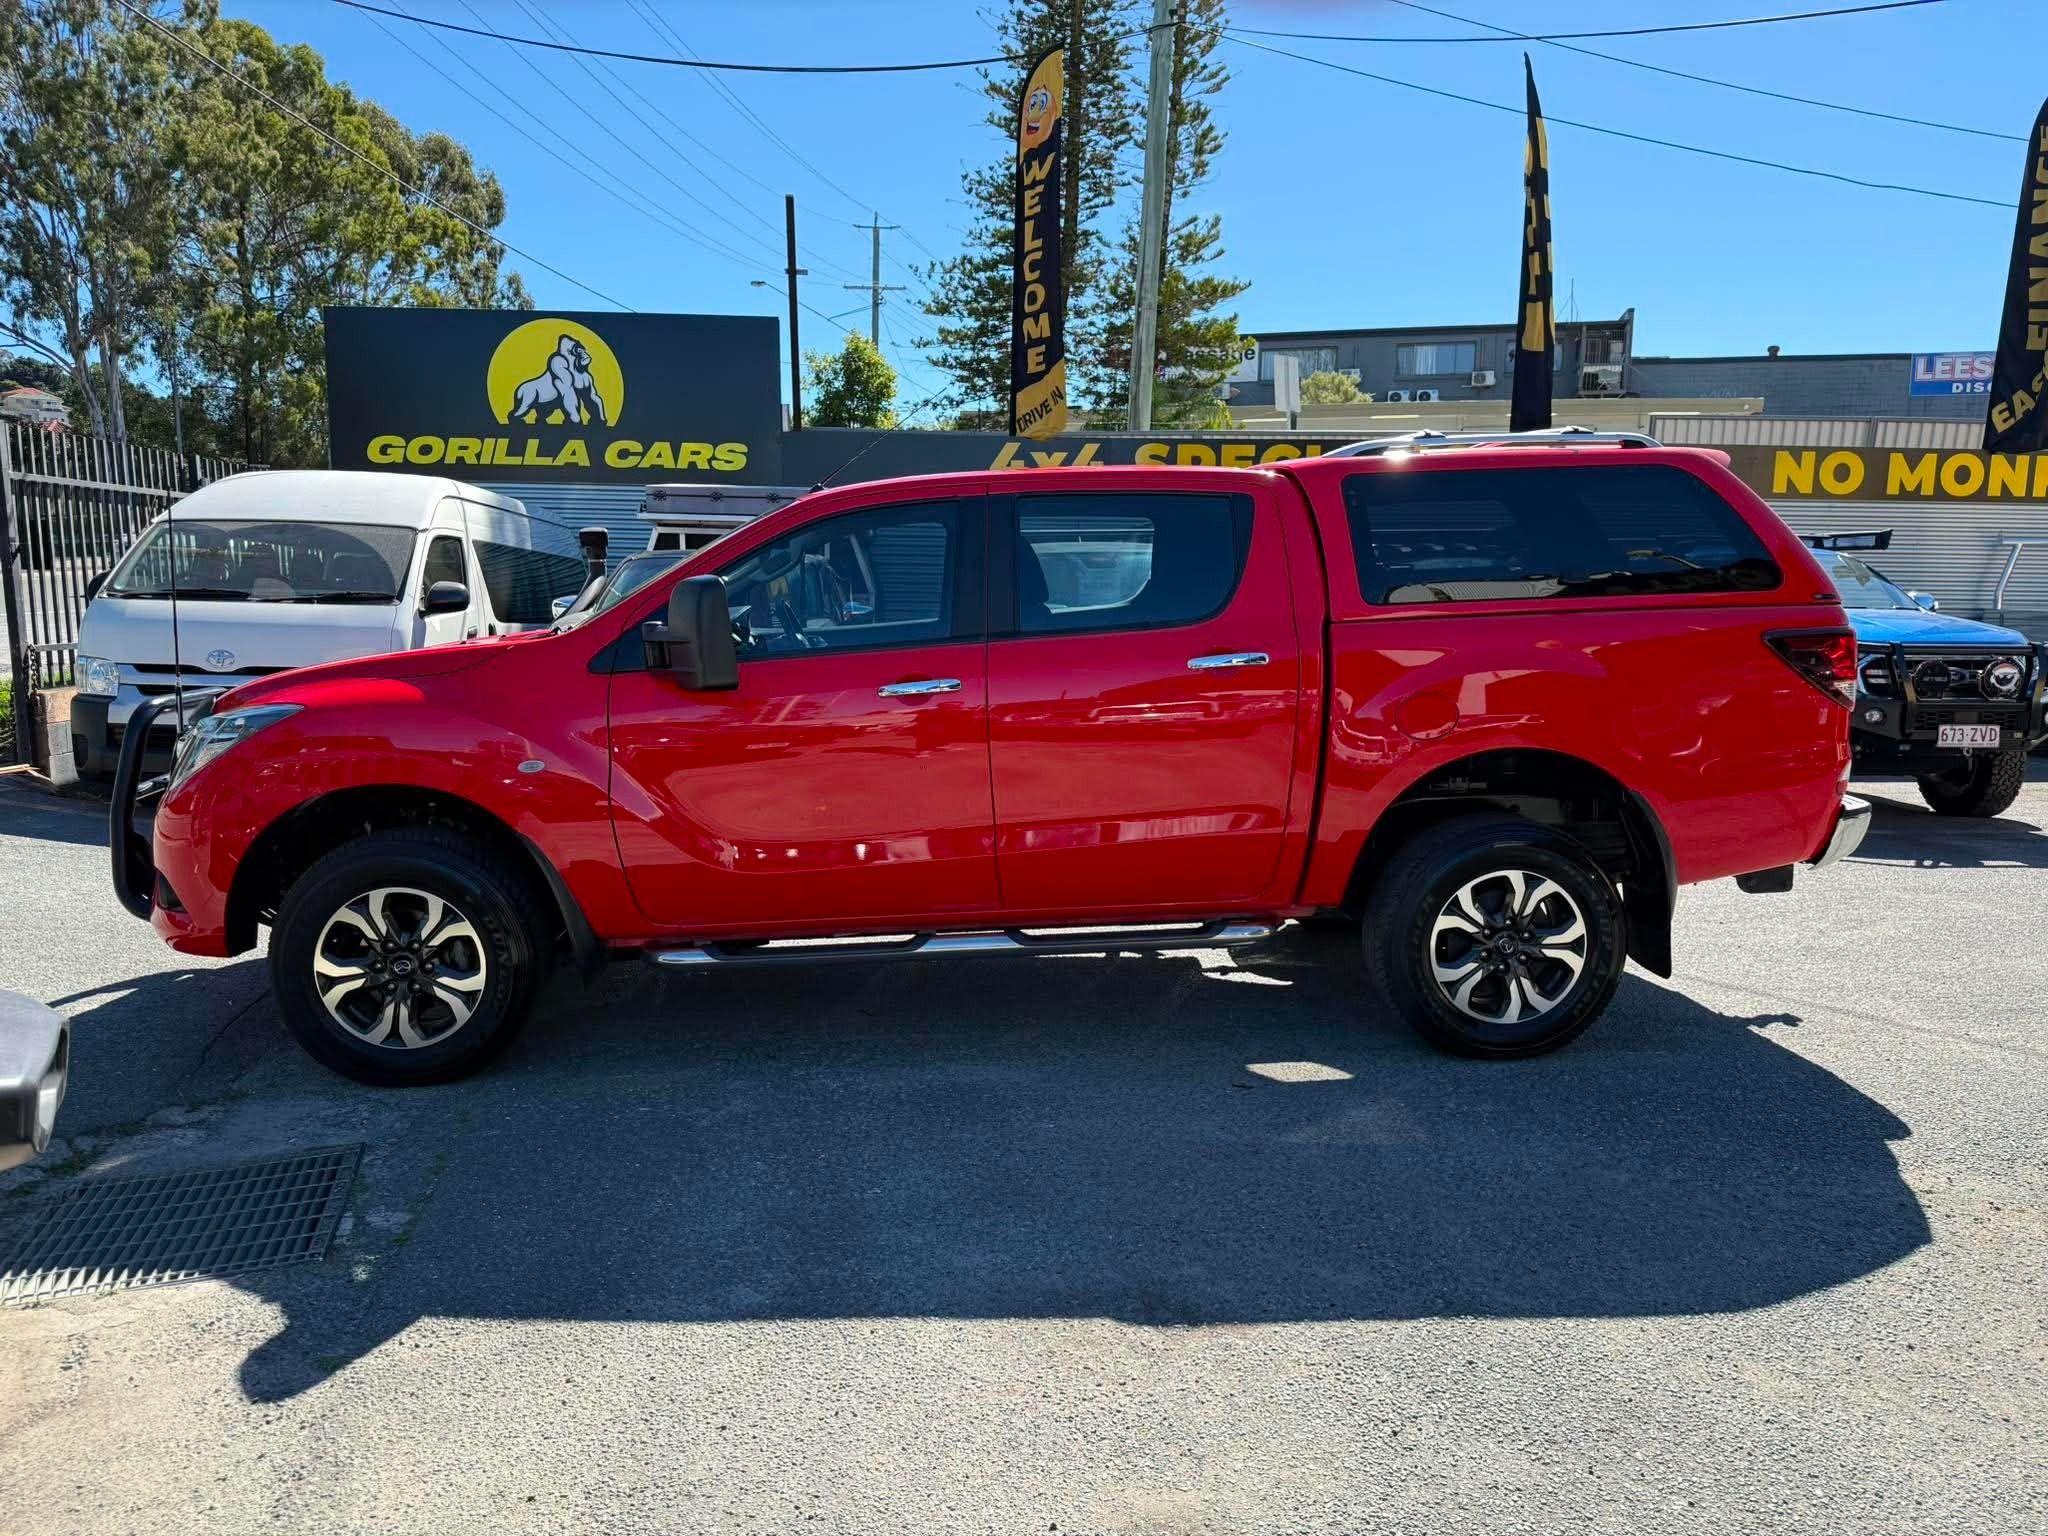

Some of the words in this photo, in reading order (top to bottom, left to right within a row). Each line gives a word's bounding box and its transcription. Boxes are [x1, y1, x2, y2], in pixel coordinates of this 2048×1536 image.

[2026, 124, 2048, 351] FINAN
[1022, 151, 1055, 374] WELCOME
[1016, 398, 1052, 434] DRIVE
[1050, 386, 1064, 406] IN
[366, 435, 591, 467] GORILLA
[604, 440, 748, 471] CARS
[989, 442, 1104, 471] 4x4
[1772, 450, 1865, 495] NO
